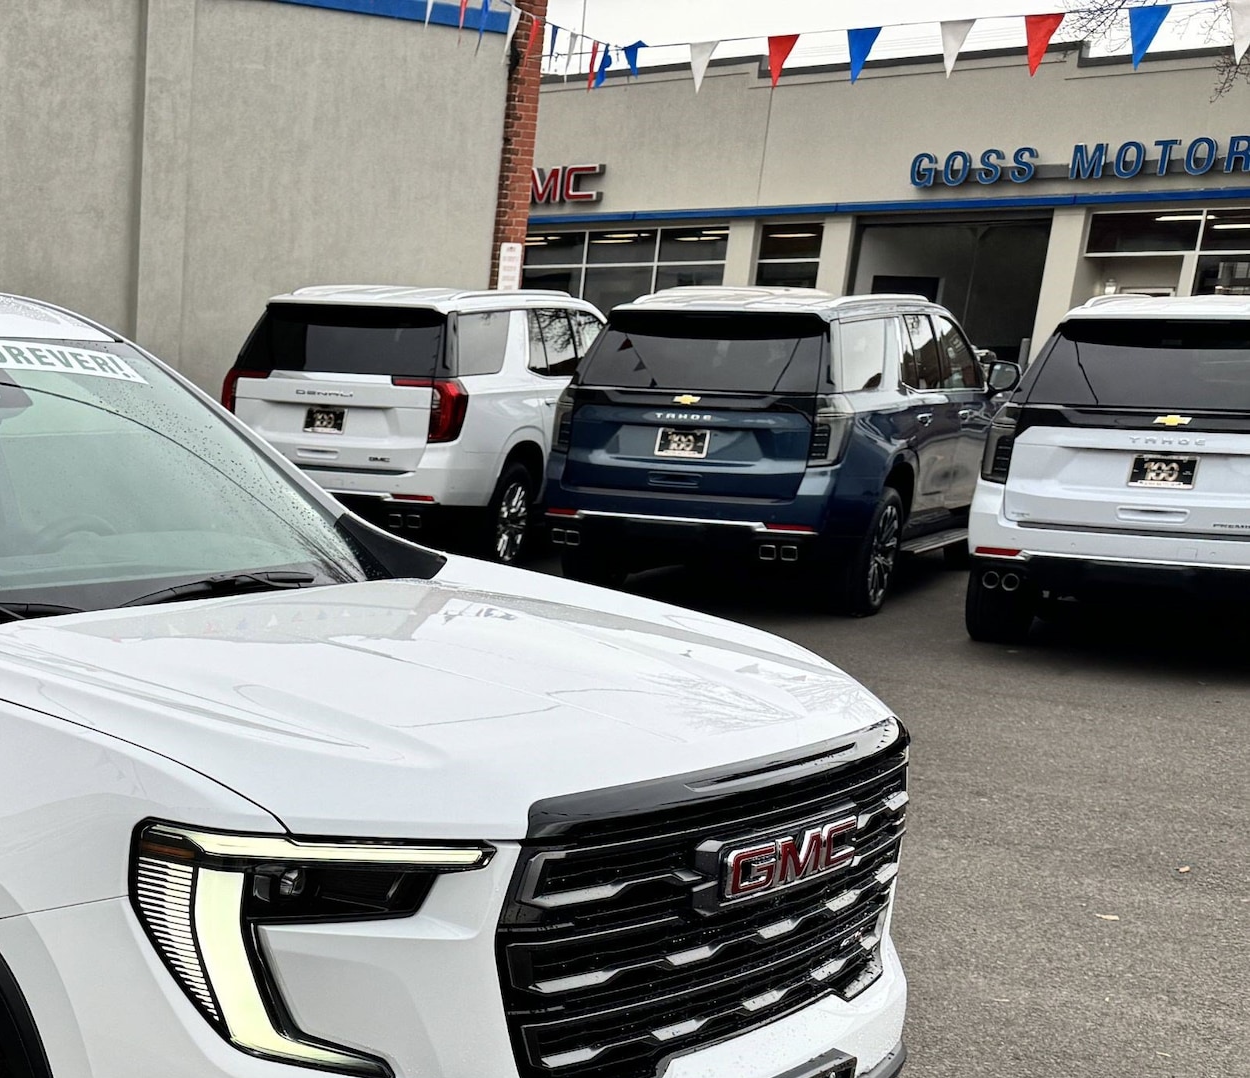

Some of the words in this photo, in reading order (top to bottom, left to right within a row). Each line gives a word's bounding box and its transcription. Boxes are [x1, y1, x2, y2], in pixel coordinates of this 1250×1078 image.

[910, 147, 1038, 188] GOSS
[531, 163, 605, 203] MC
[295, 389, 354, 398] DENALI
[654, 412, 712, 420] TAHOE
[1129, 436, 1206, 446] TAHOE
[725, 816, 857, 899] GMC
